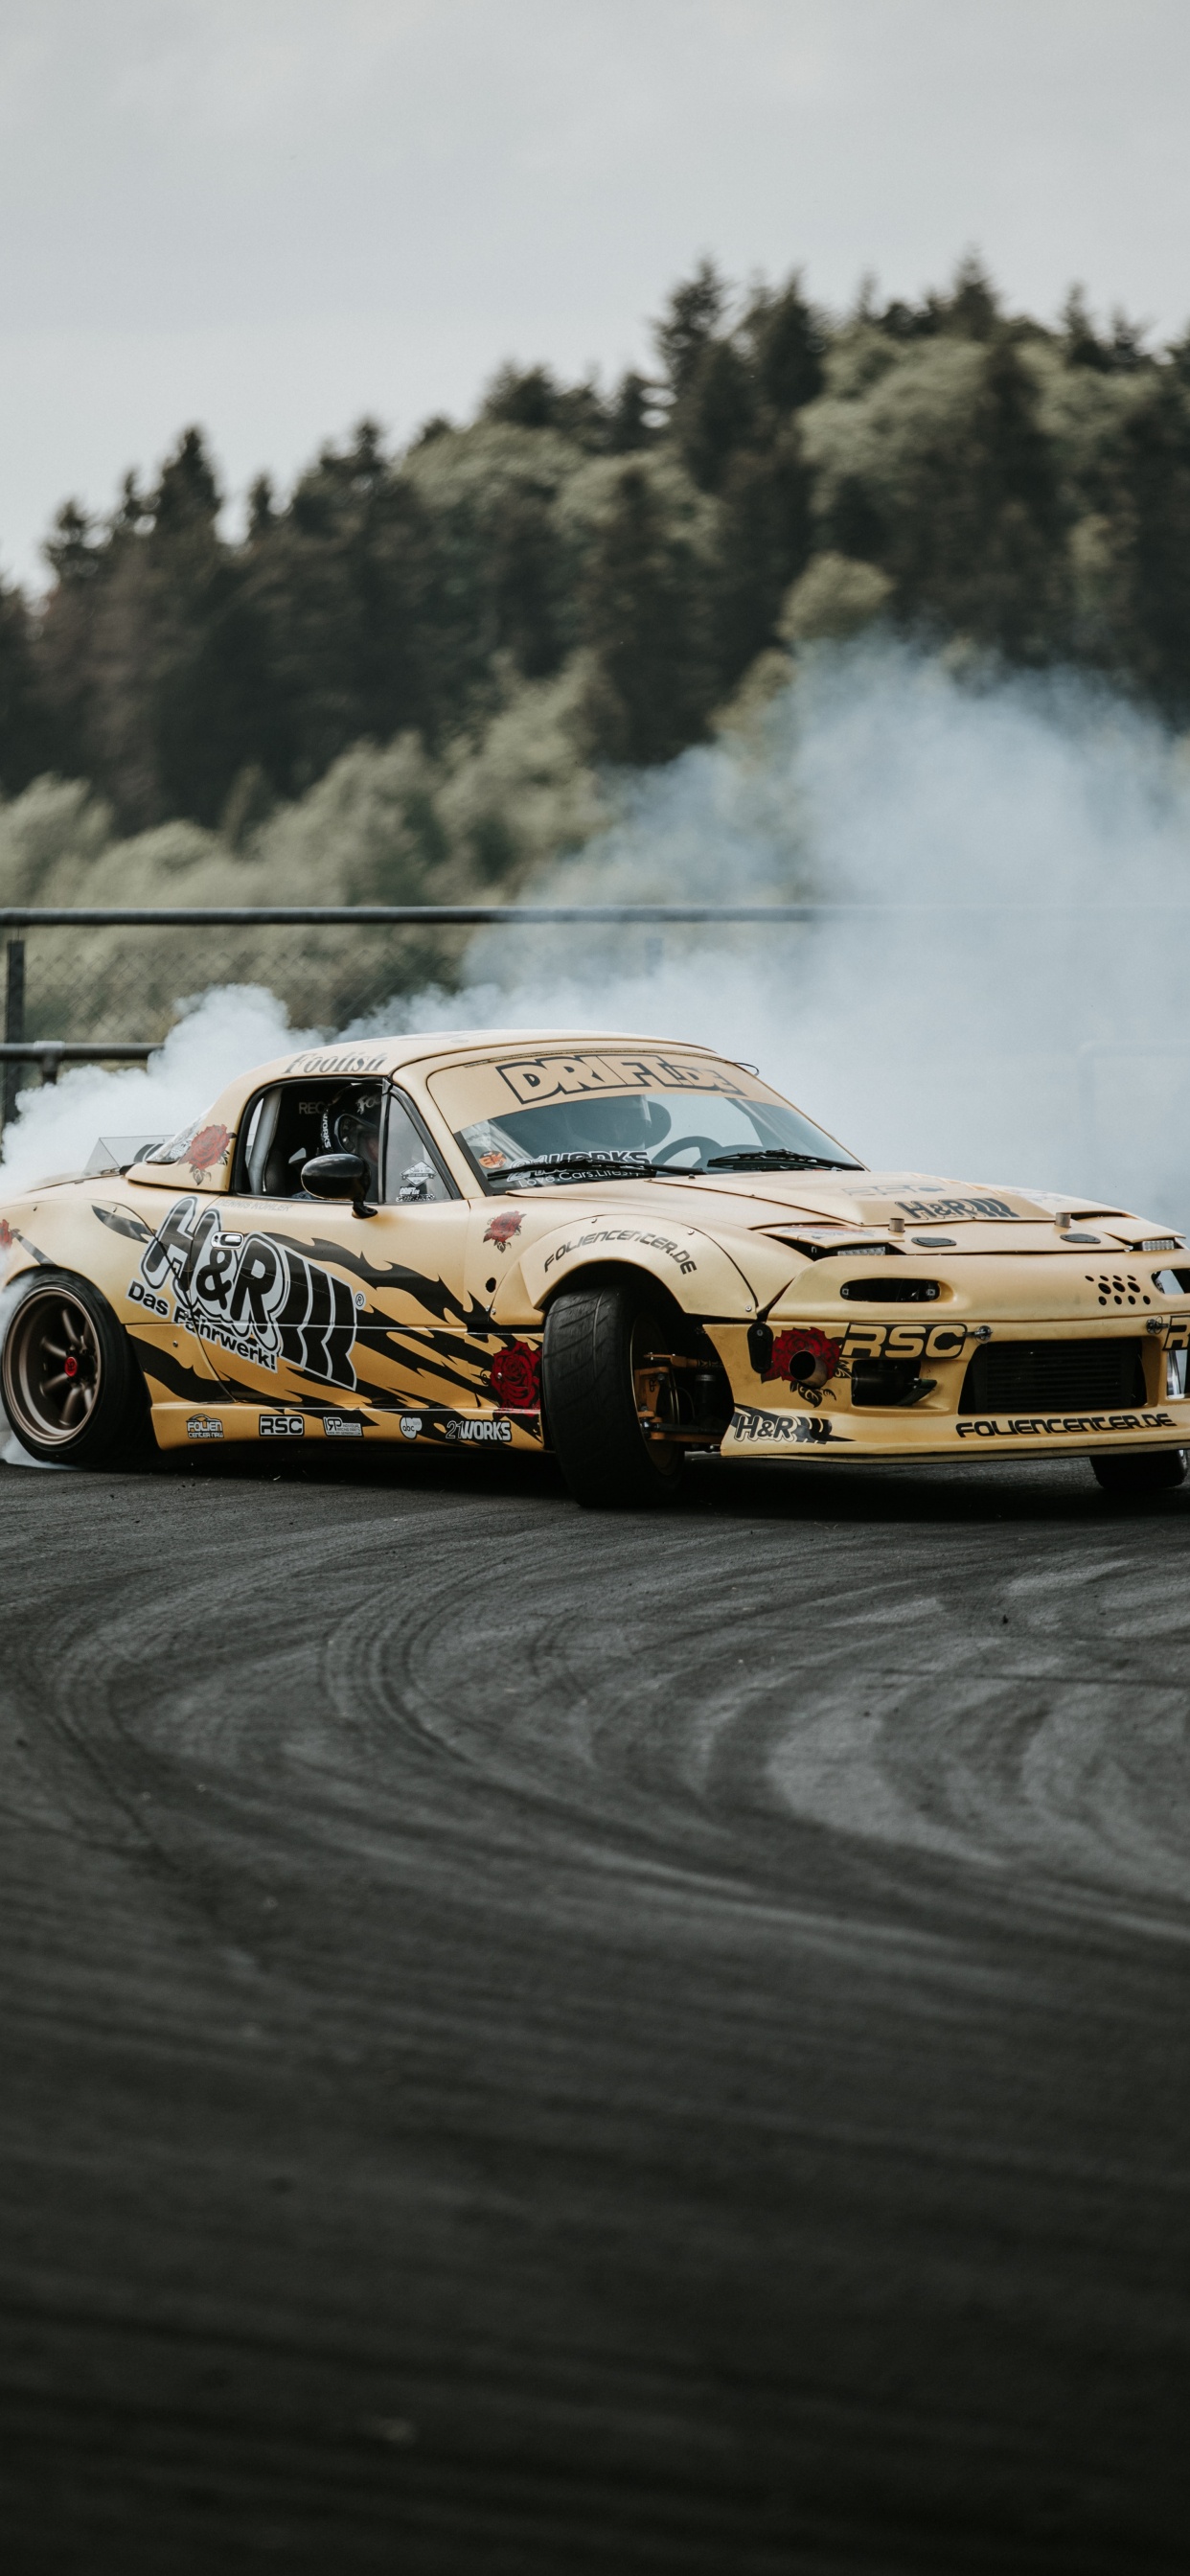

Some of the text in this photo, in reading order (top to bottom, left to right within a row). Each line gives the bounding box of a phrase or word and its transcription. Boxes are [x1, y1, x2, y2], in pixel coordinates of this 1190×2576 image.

[281, 1052, 388, 1074] Foolish
[895, 1199, 979, 1220] H&R
[128, 1281, 169, 1316] Das
[841, 1324, 967, 1358] RSC
[187, 1421, 222, 1432] FOLIEN
[261, 1417, 303, 1434] RSC
[734, 1415, 797, 1442] H&R
[955, 1413, 1178, 1438] FOLIENCENTER.DE
